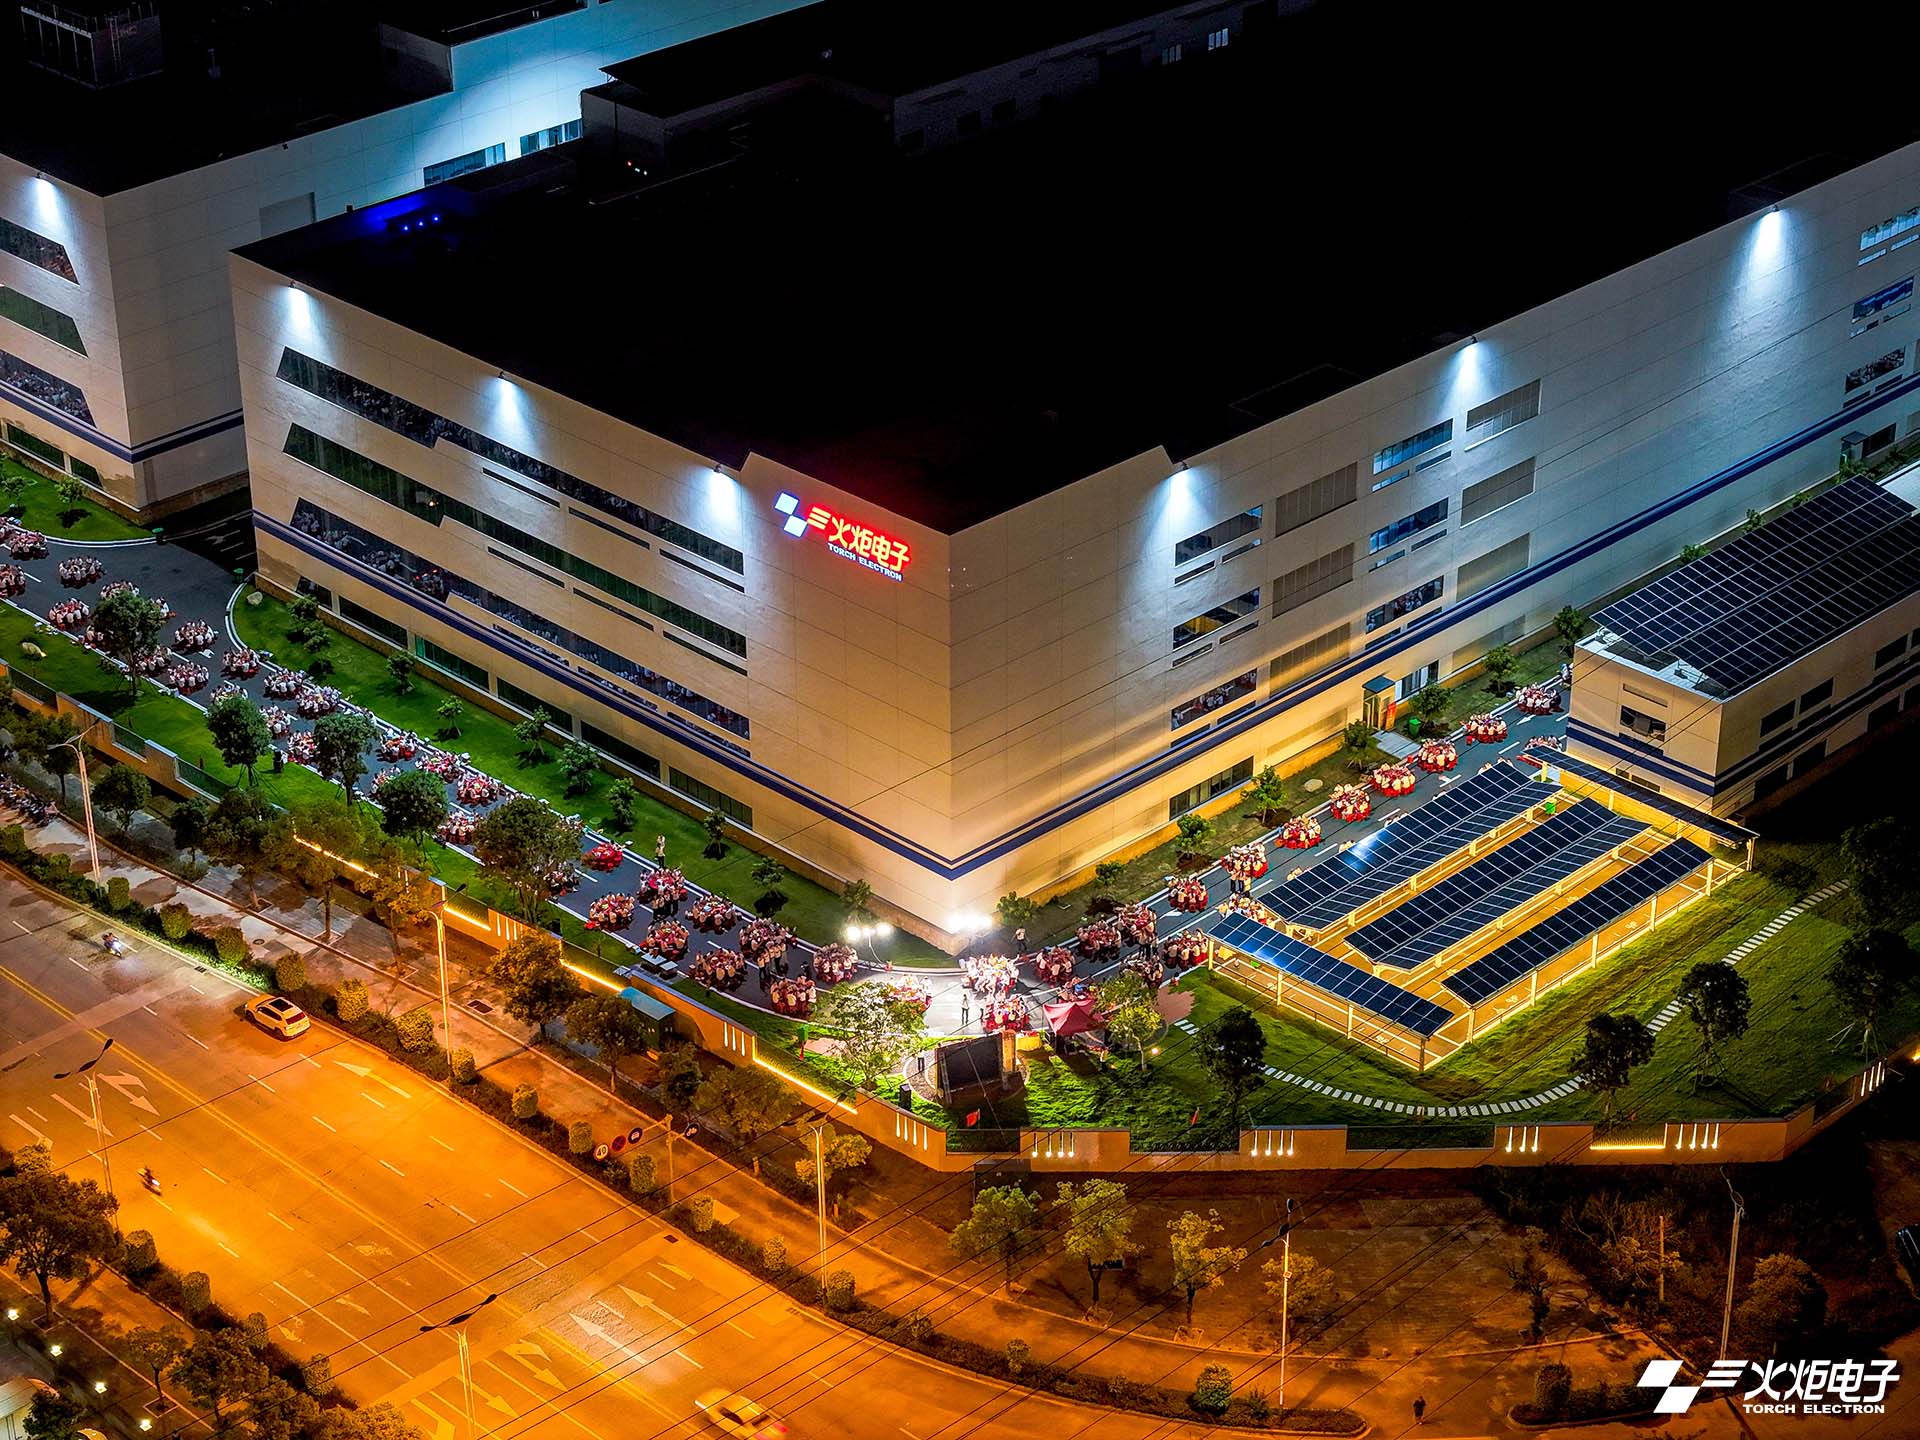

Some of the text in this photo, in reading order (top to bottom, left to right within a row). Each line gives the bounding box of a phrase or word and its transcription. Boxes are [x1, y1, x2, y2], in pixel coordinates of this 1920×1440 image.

[828, 516, 910, 572] 火炬电子
[828, 543, 903, 581] TORCH ELECTRON
